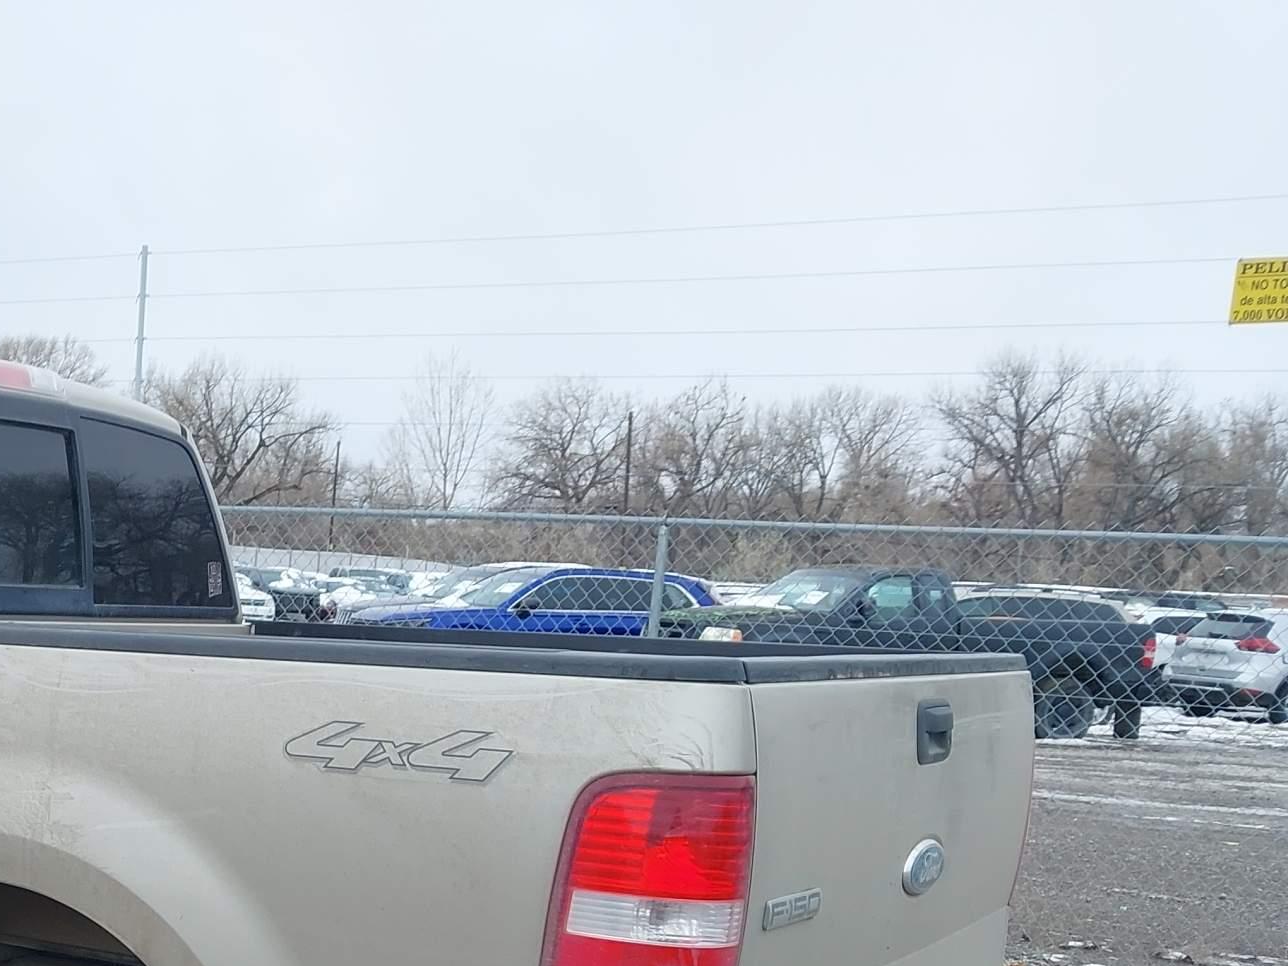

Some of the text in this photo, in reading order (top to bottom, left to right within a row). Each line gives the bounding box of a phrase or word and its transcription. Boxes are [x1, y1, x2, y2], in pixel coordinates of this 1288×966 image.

[1241, 262, 1288, 275] PELI
[1251, 280, 1269, 290] NO
[1240, 295, 1254, 306] de
[1257, 294, 1278, 304] alta
[285, 720, 514, 783] 4x4
